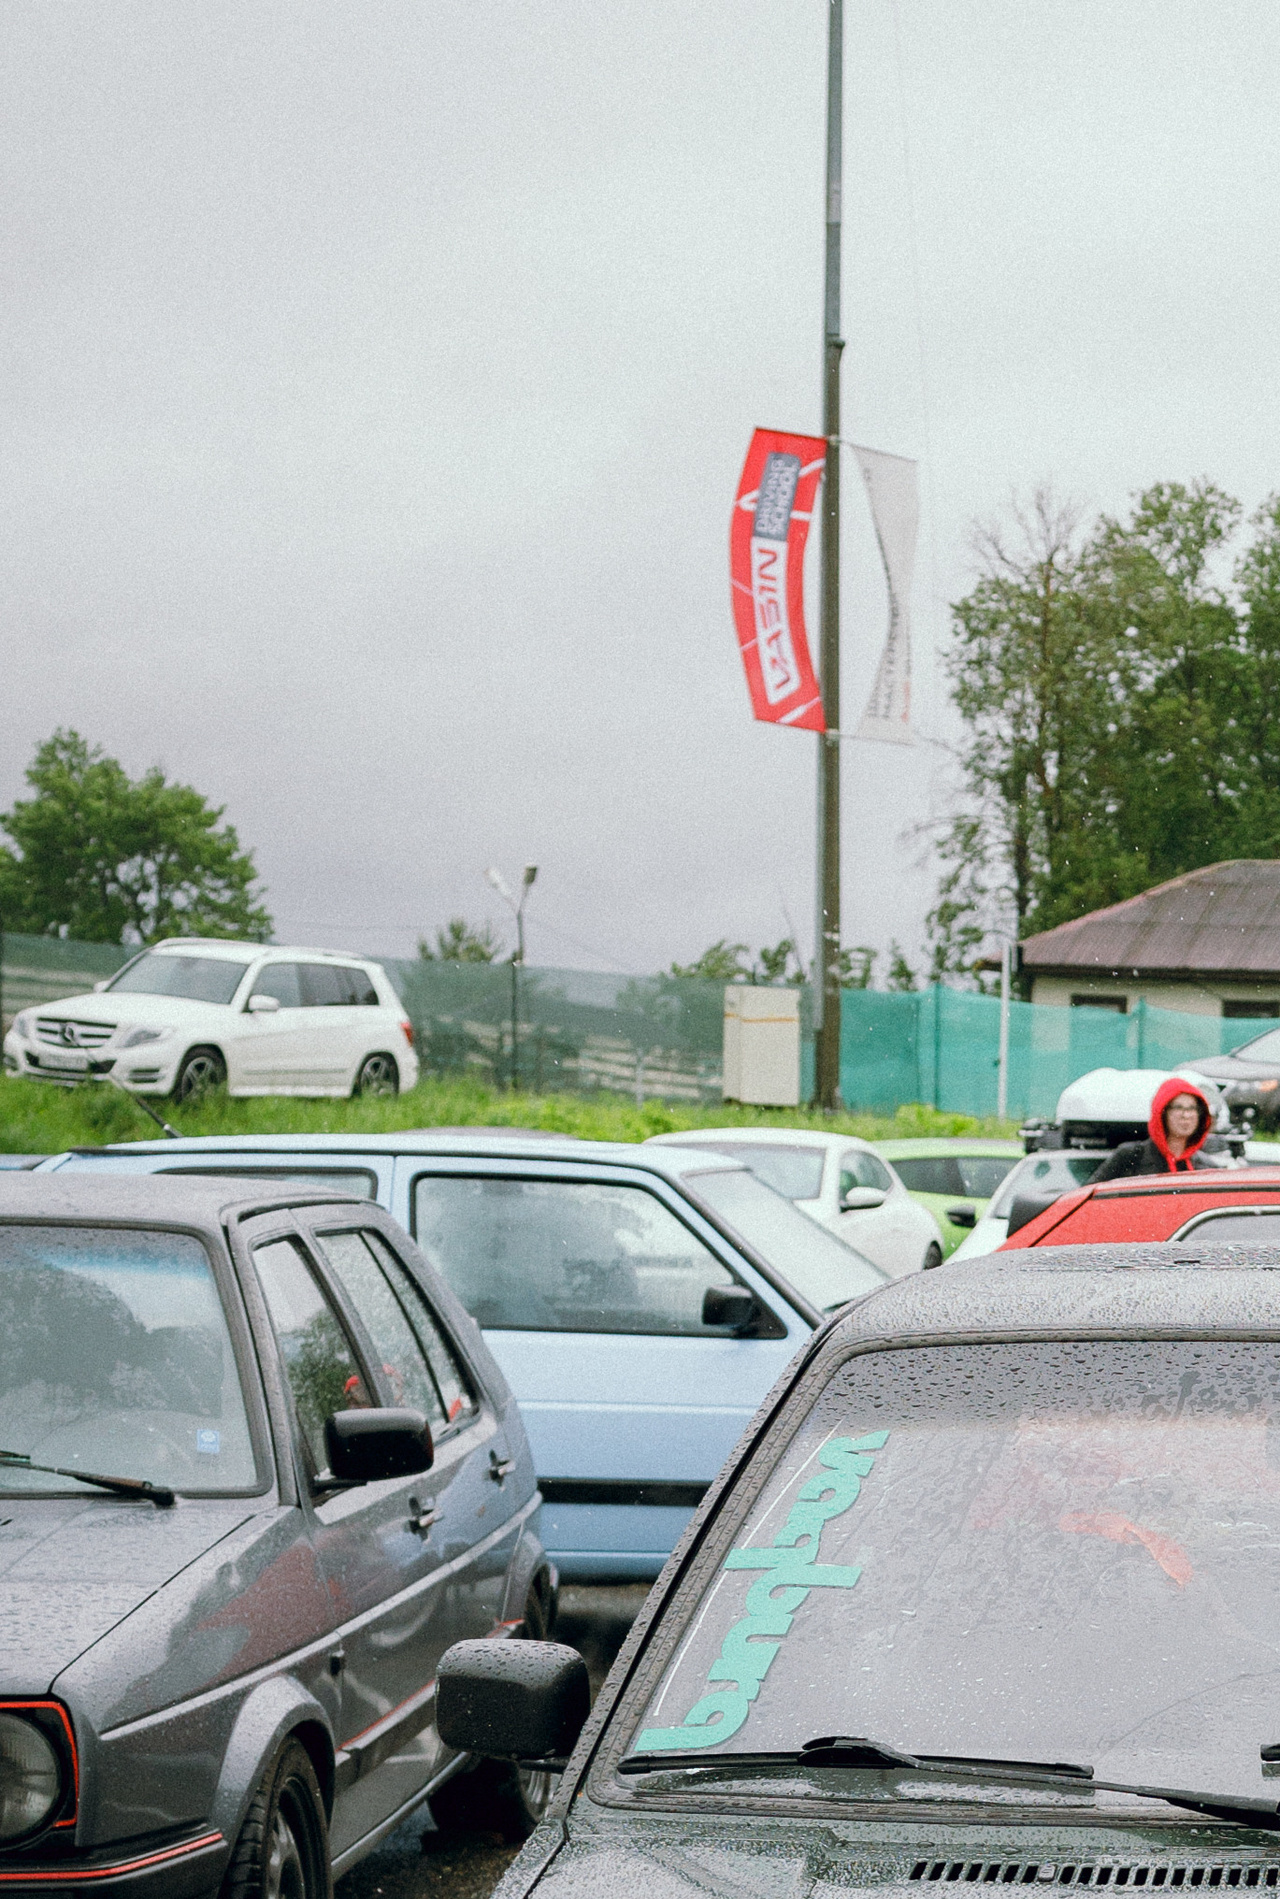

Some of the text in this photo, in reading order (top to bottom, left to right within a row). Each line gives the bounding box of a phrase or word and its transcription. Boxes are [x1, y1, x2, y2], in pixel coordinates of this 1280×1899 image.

[755, 458, 785, 533] DRIVING
[768, 463, 799, 536] SCHOOL
[758, 547, 791, 690] VASIN
